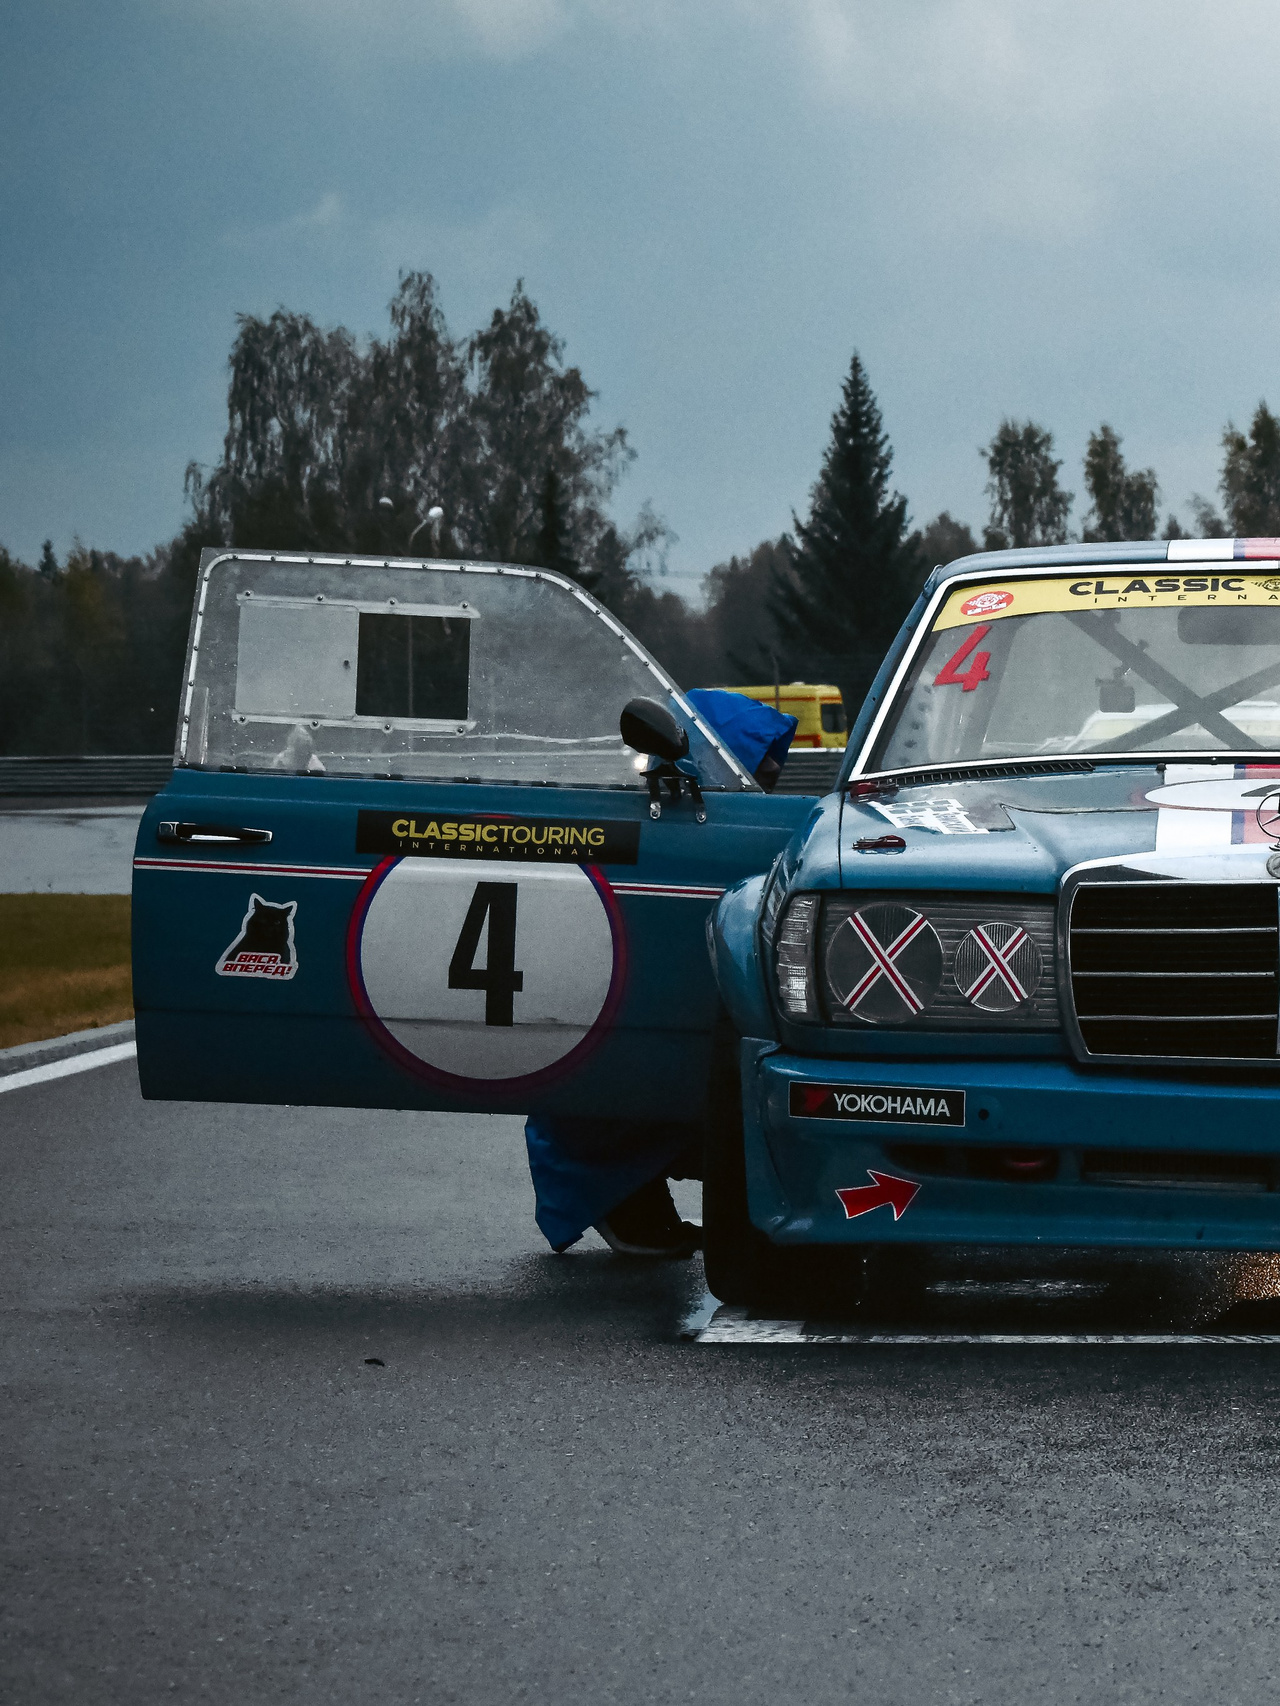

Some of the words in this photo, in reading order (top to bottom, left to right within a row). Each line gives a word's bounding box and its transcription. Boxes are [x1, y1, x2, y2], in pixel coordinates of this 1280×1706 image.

[1068, 578, 1246, 596] CLASSIC
[931, 624, 993, 692] 4
[399, 840, 594, 856] INTERNATIONAL
[448, 881, 523, 1027] 4
[833, 1092, 951, 1117] YOKOHAMA
